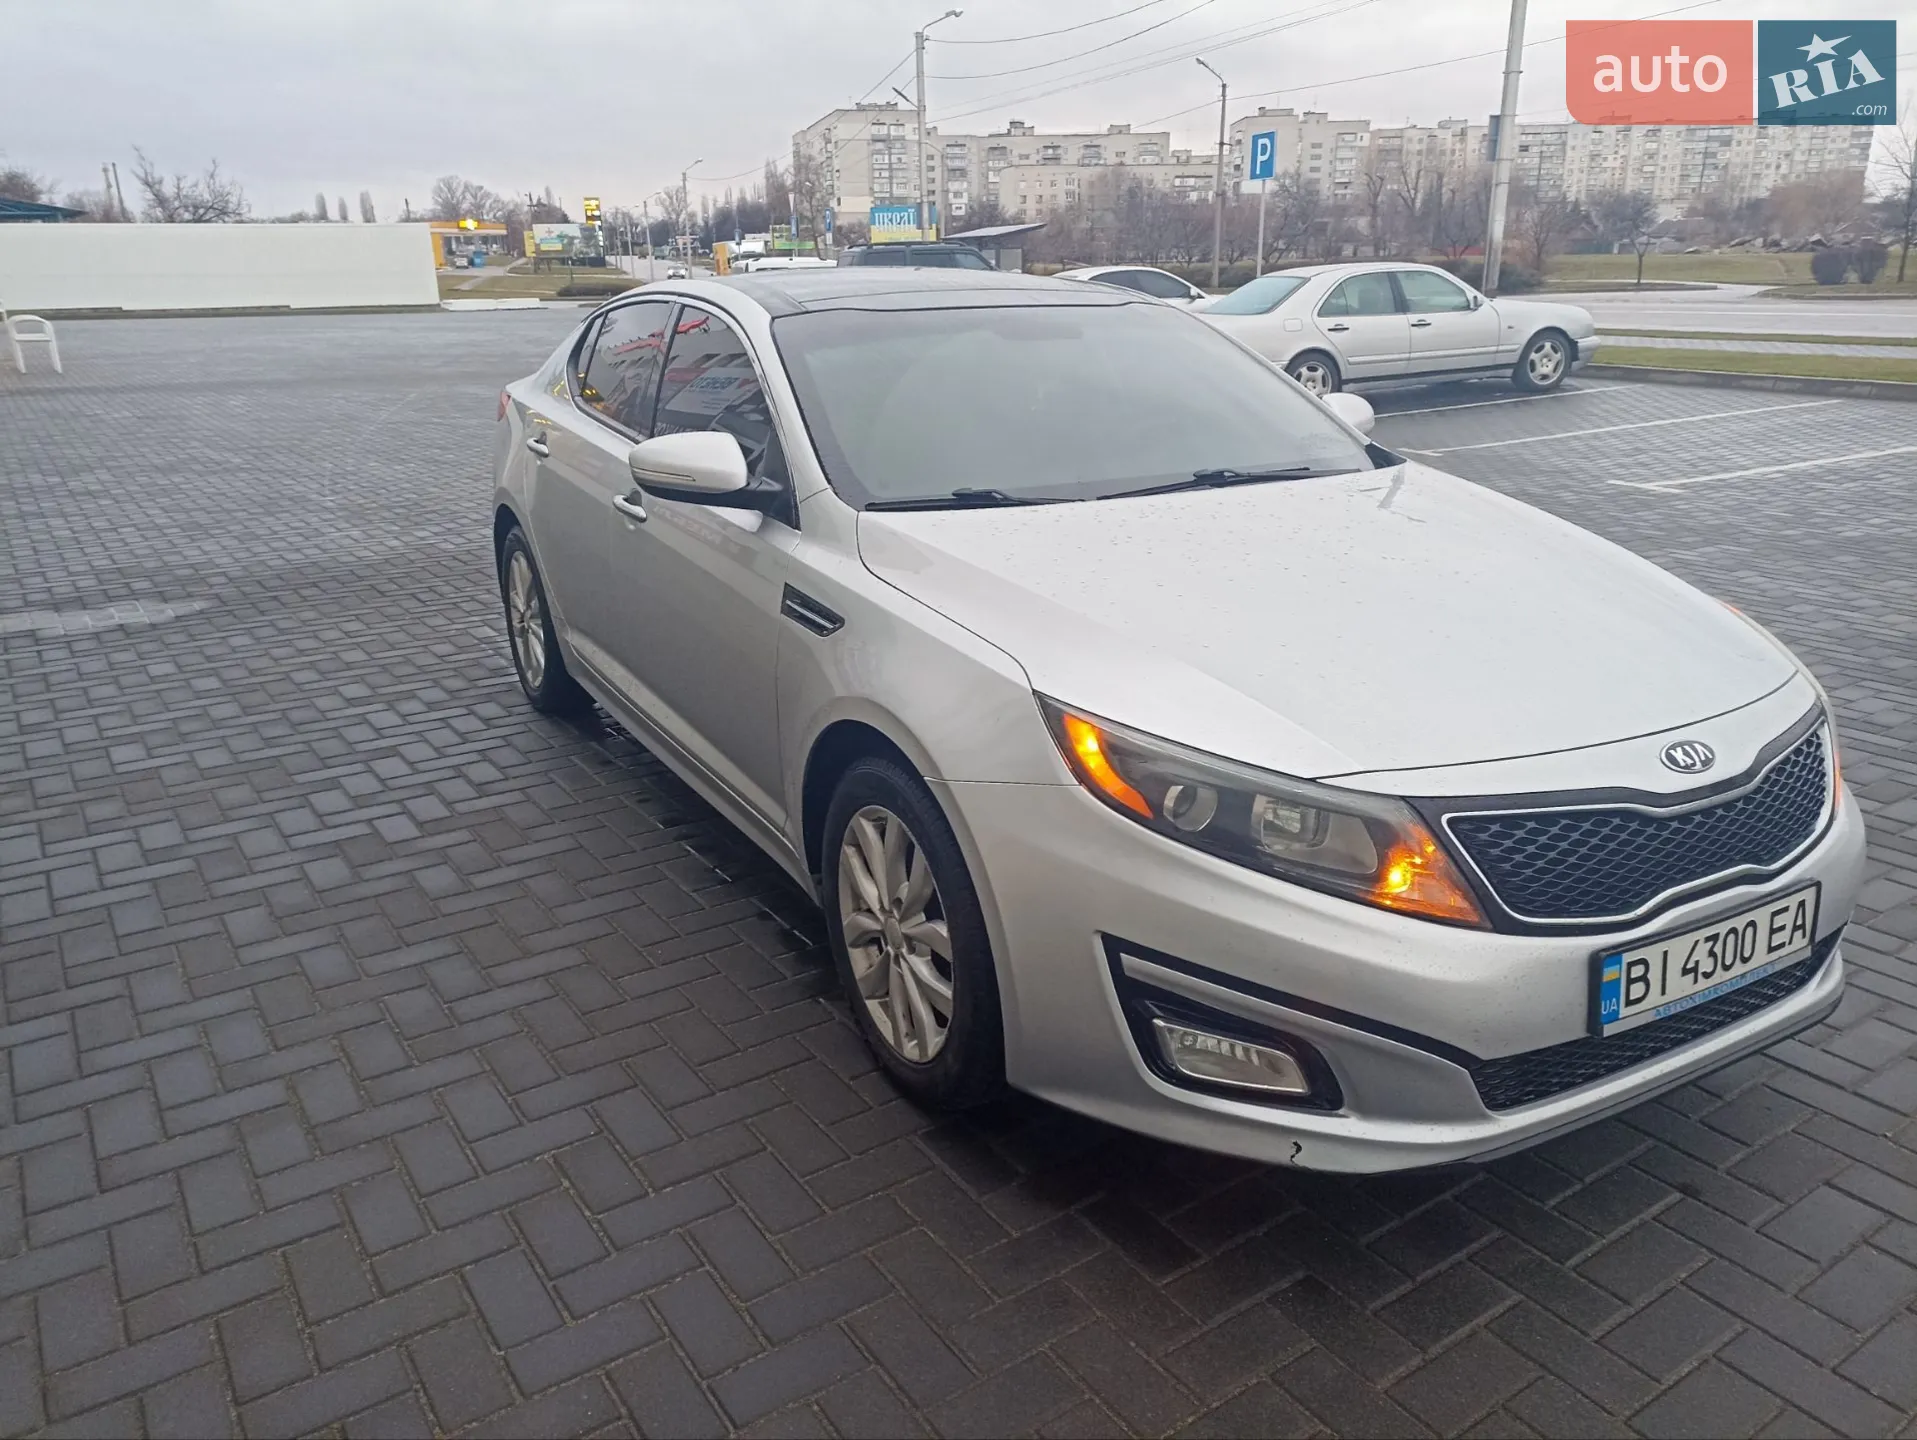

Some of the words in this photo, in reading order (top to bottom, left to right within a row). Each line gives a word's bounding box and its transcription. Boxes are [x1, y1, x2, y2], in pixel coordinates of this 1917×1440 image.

[1255, 137, 1271, 175] P
[1667, 742, 1713, 770] KIA
[1623, 948, 1669, 1007] BI
[1680, 919, 1758, 986] 4300
[1766, 898, 1808, 954] EA
[1600, 996, 1619, 1014] UA
